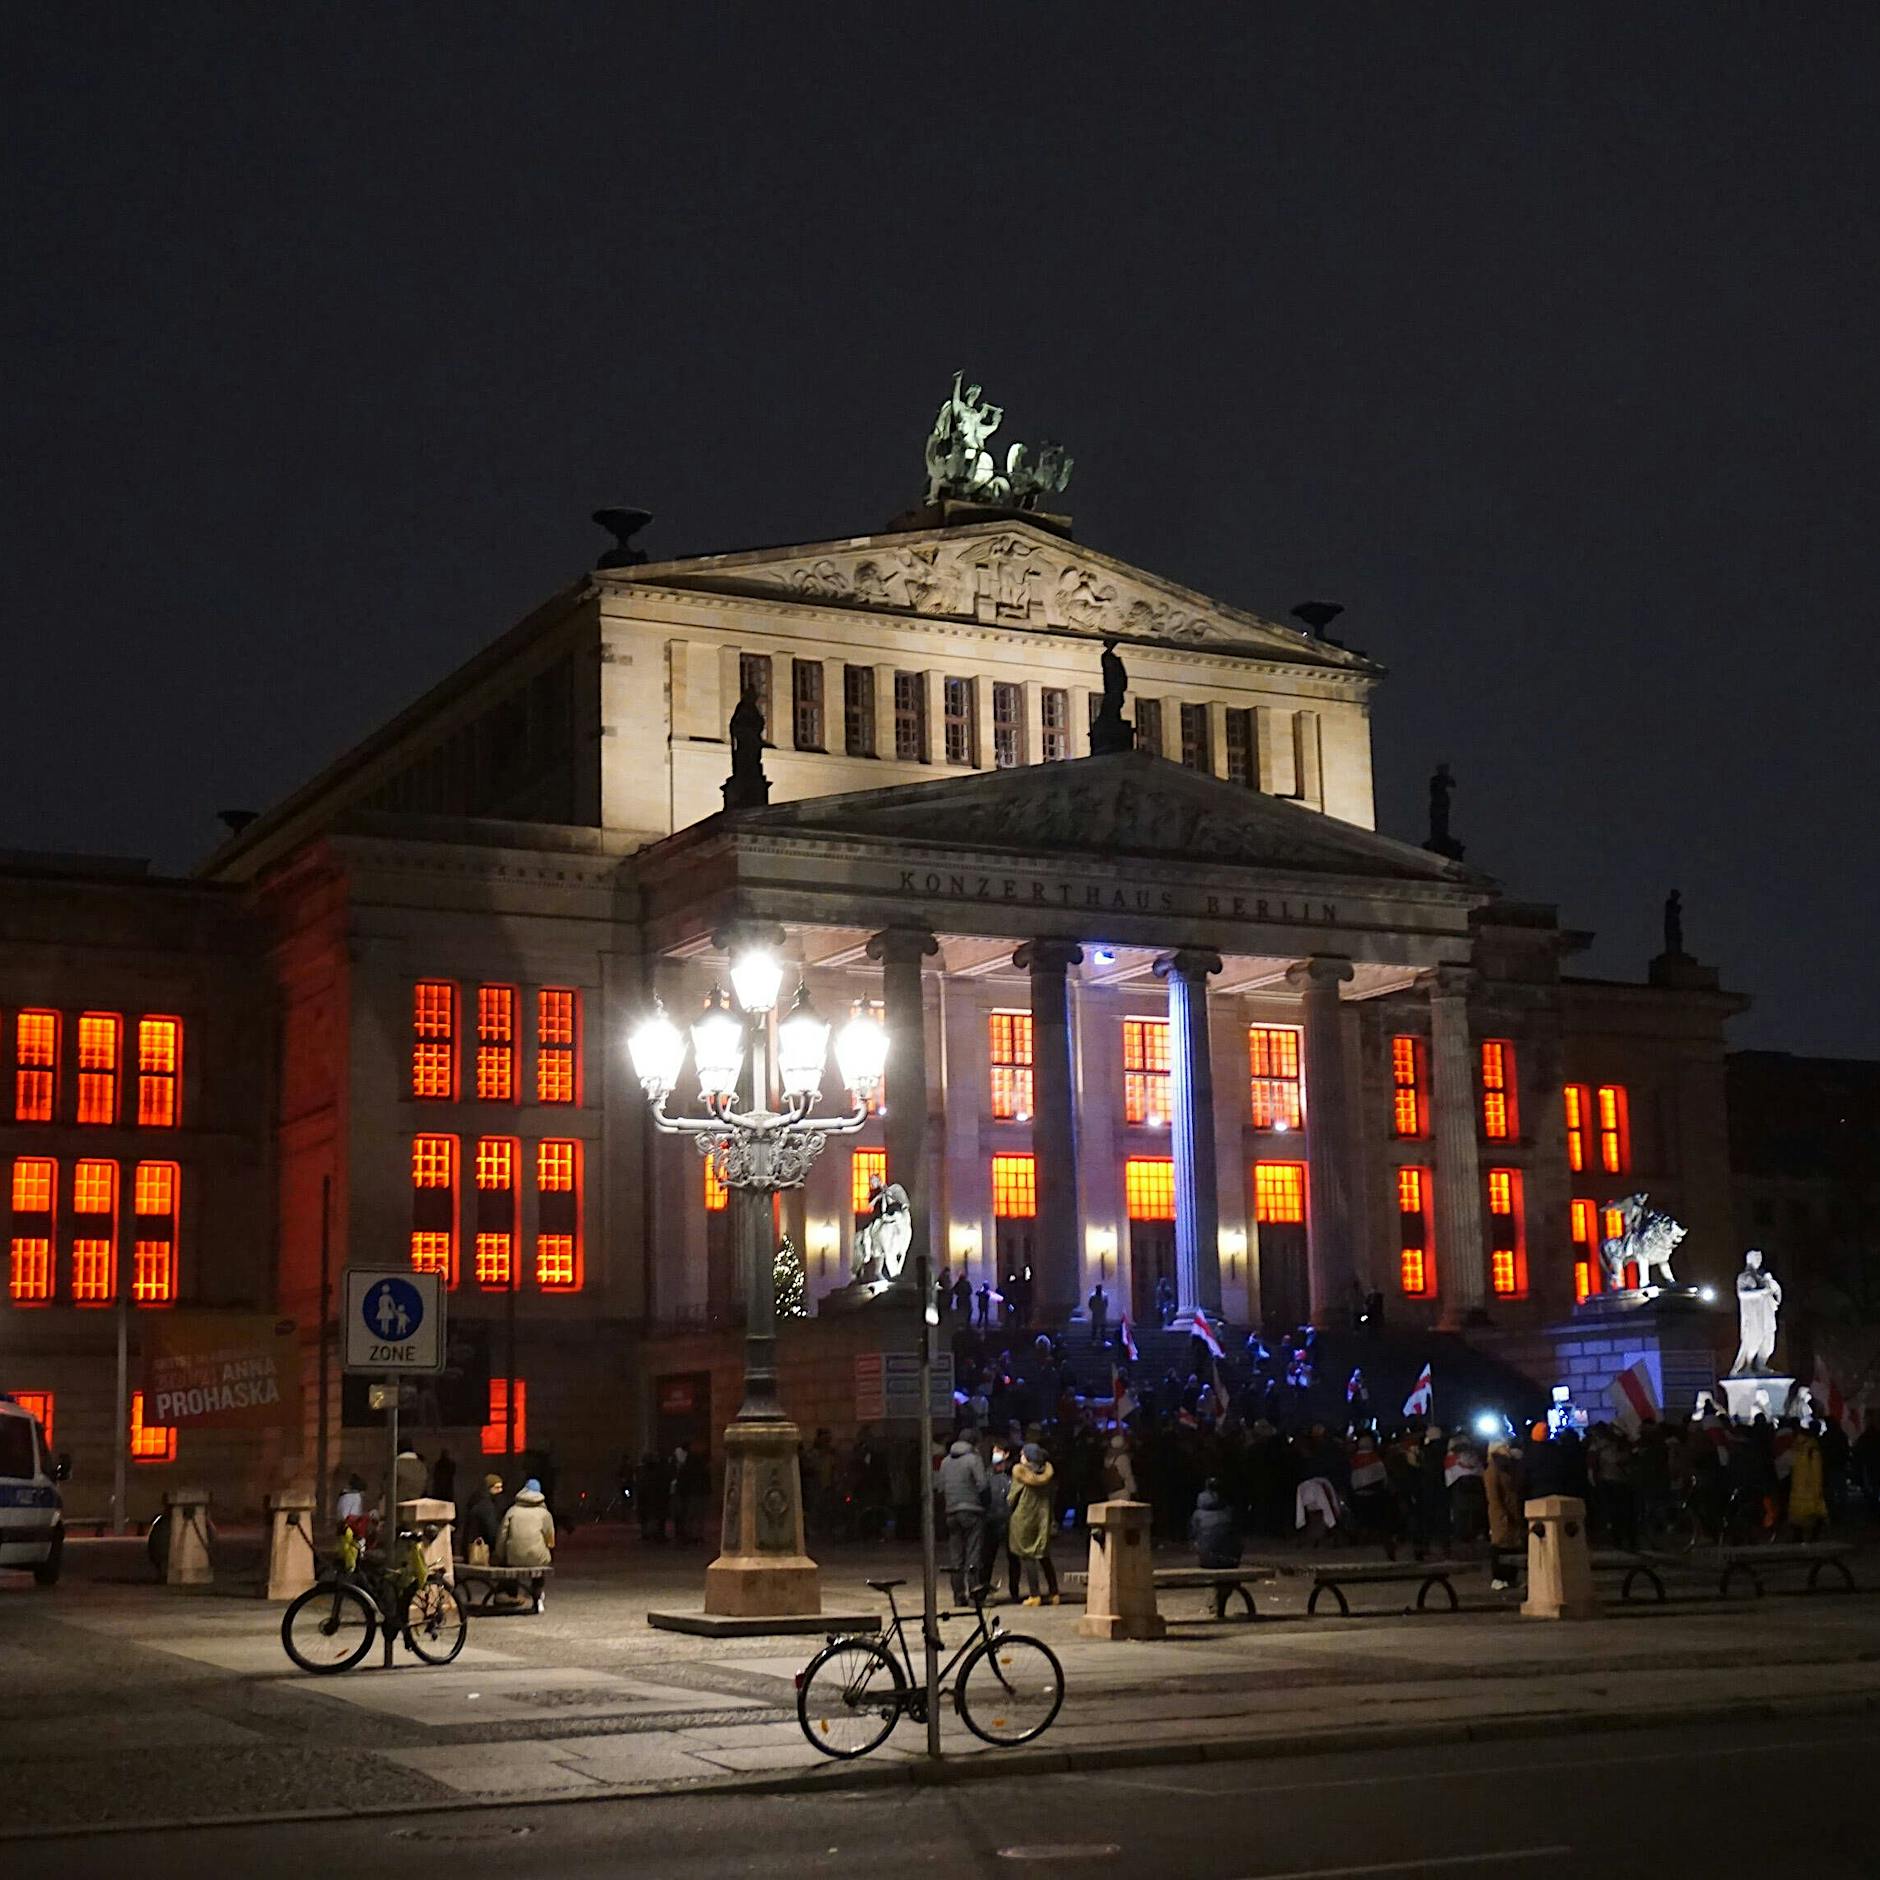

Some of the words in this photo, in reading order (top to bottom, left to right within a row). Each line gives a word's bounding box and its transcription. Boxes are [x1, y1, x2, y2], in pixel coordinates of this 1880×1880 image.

[900, 872, 1173, 910] KONZERTHAUS
[1207, 896, 1337, 922] BERLIN
[223, 1357, 277, 1381] ANNA
[369, 1346, 416, 1361] ZONE
[156, 1378, 280, 1420] PROHASKA
